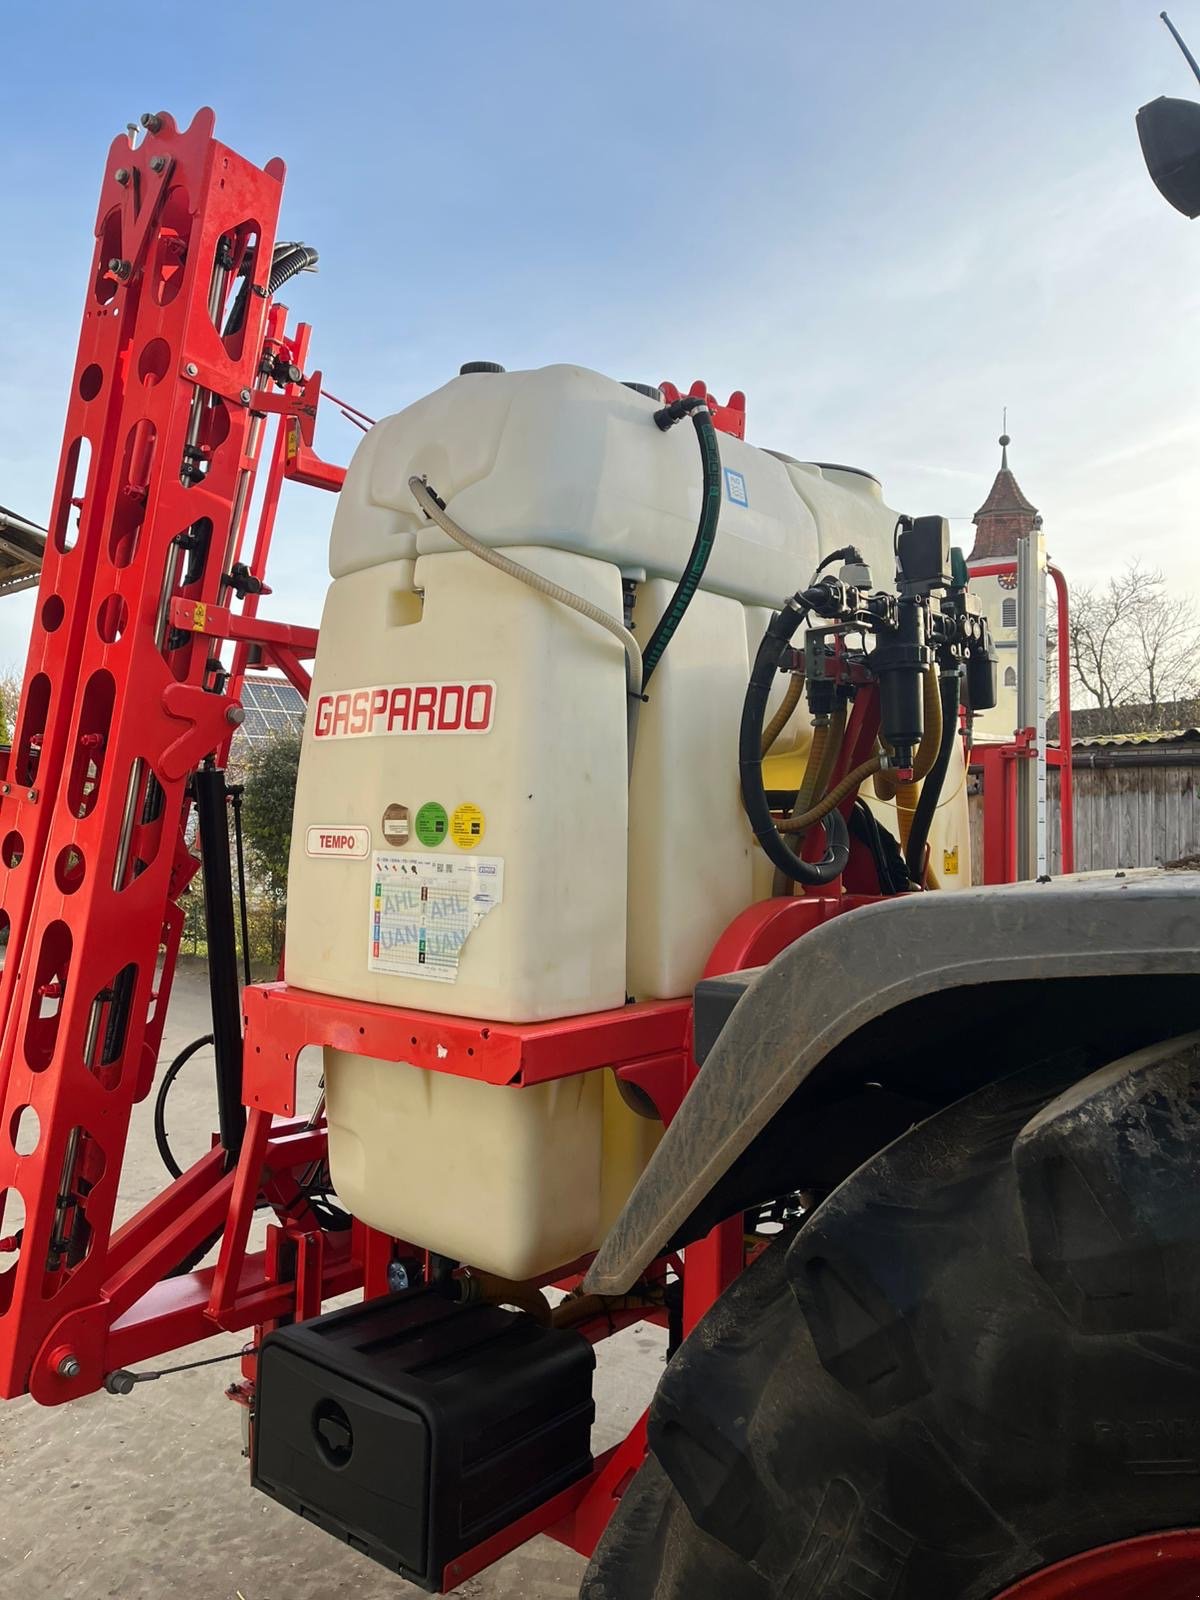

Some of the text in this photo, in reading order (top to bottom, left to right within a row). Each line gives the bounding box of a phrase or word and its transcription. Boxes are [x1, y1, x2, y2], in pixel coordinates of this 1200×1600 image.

[315, 684, 493, 737] GASPARDO
[319, 835, 355, 849] TEMPO
[384, 890, 419, 914] AHL
[431, 895, 468, 919] AHL
[381, 924, 418, 949] UAN
